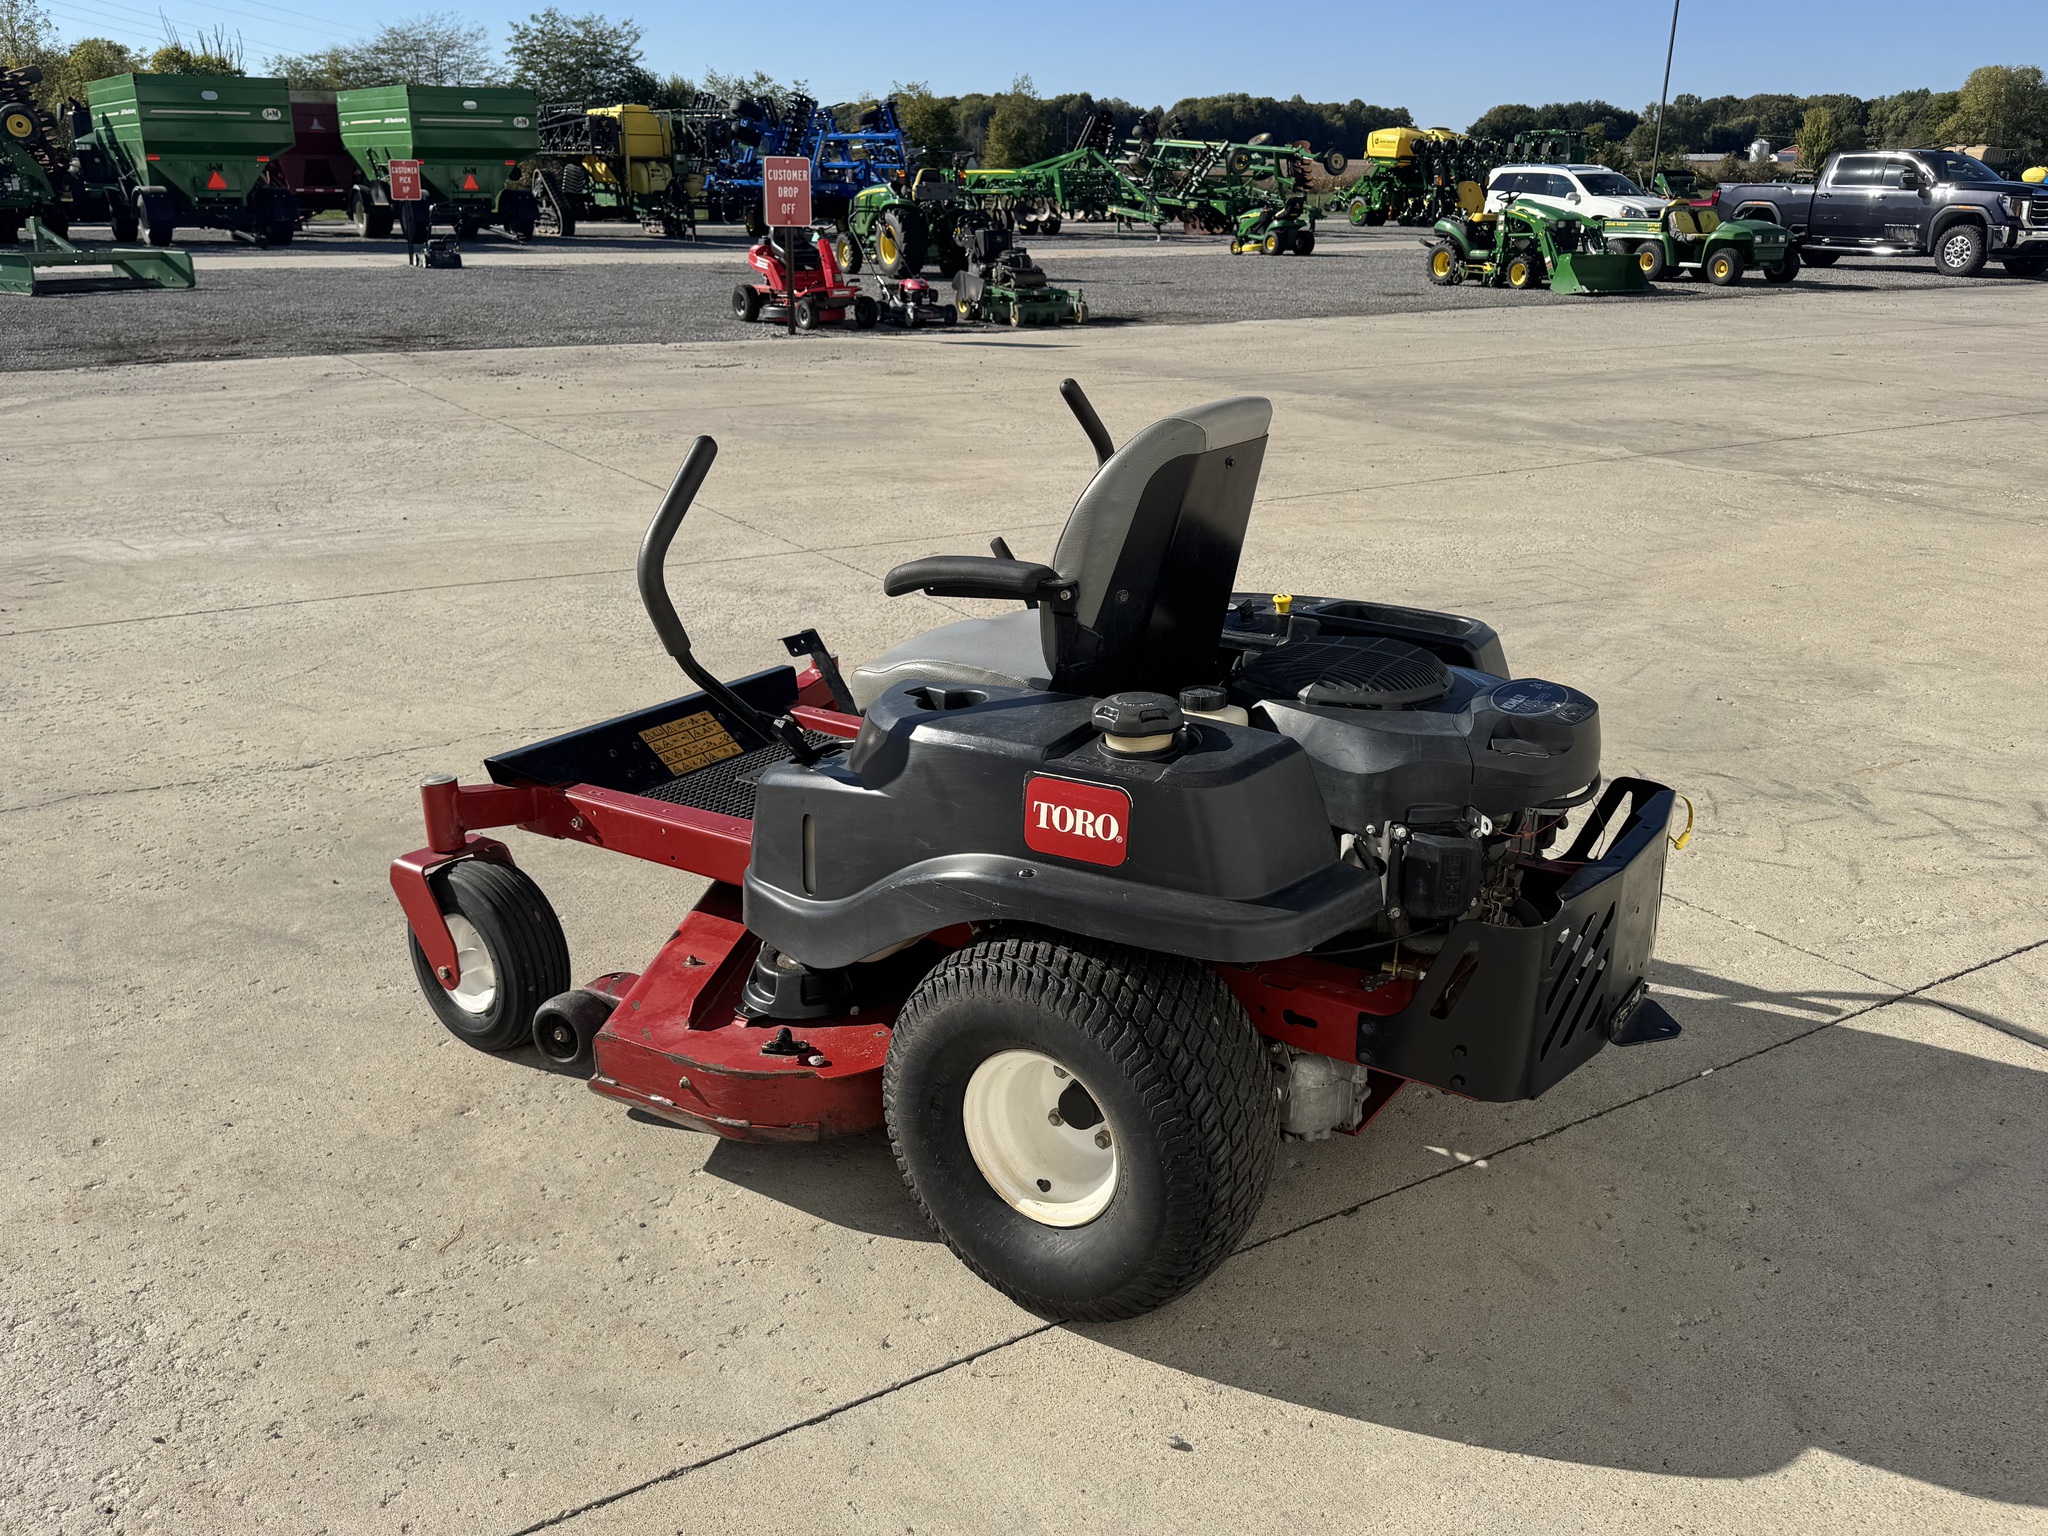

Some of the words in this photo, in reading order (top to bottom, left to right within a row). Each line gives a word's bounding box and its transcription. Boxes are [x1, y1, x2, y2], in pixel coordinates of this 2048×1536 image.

[391, 166, 418, 174] CUSTOMER
[767, 169, 808, 181] CUSTOMER
[399, 176, 411, 184] PICK
[777, 186, 799, 198] DROP
[781, 203, 796, 215] OFF
